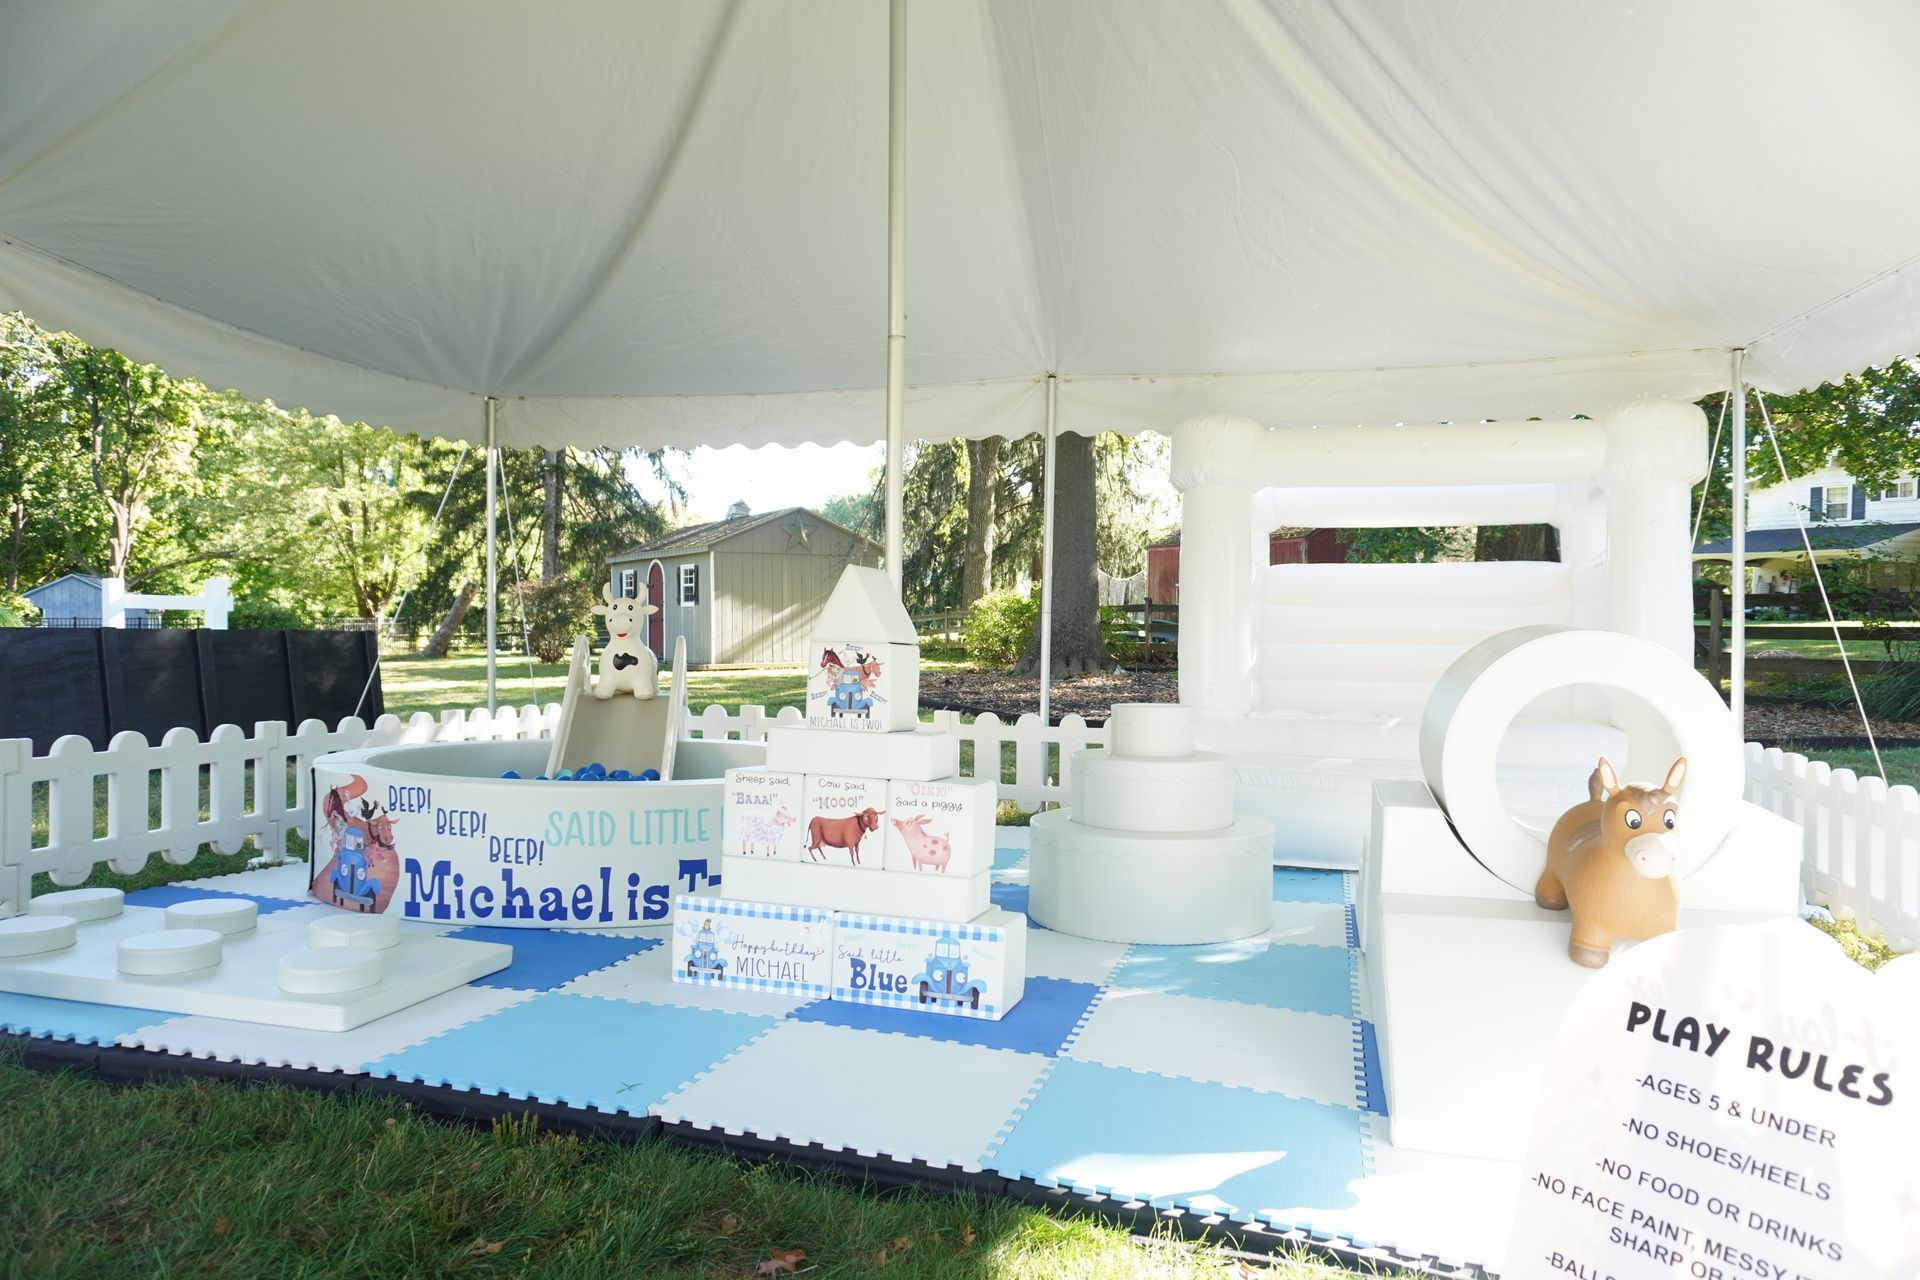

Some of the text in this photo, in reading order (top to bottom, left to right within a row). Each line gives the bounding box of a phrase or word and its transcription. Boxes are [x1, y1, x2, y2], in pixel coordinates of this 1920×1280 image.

[809, 716, 847, 729] MICHAEL
[850, 719, 859, 730] IS
[736, 773, 766, 784] Sheep
[818, 778, 841, 788] Cow
[388, 785, 432, 814] BEEP!
[895, 796, 963, 812] Said a piggy
[436, 807, 487, 838] BEEP!
[544, 810, 617, 848] SAID
[629, 808, 710, 846] LITTLE
[489, 835, 544, 866] BEEP!
[404, 857, 613, 923] Michael
[627, 872, 670, 921] is
[736, 956, 809, 983] MICHAEL
[850, 957, 908, 994] Blue
[1626, 1001, 1730, 1057] PLAY
[1746, 1035, 1894, 1107] RULES
[1635, 1074, 1836, 1148] -AGES 5 & UNDER
[1622, 1117, 1832, 1200] -NO SHOES/HEELS
[1531, 1172, 1787, 1280] -NO FACE PAINT, MESSY
[1595, 1157, 1843, 1261] -NO FOOD OR DRINKS
[1609, 1226, 1684, 1266] SHARP
